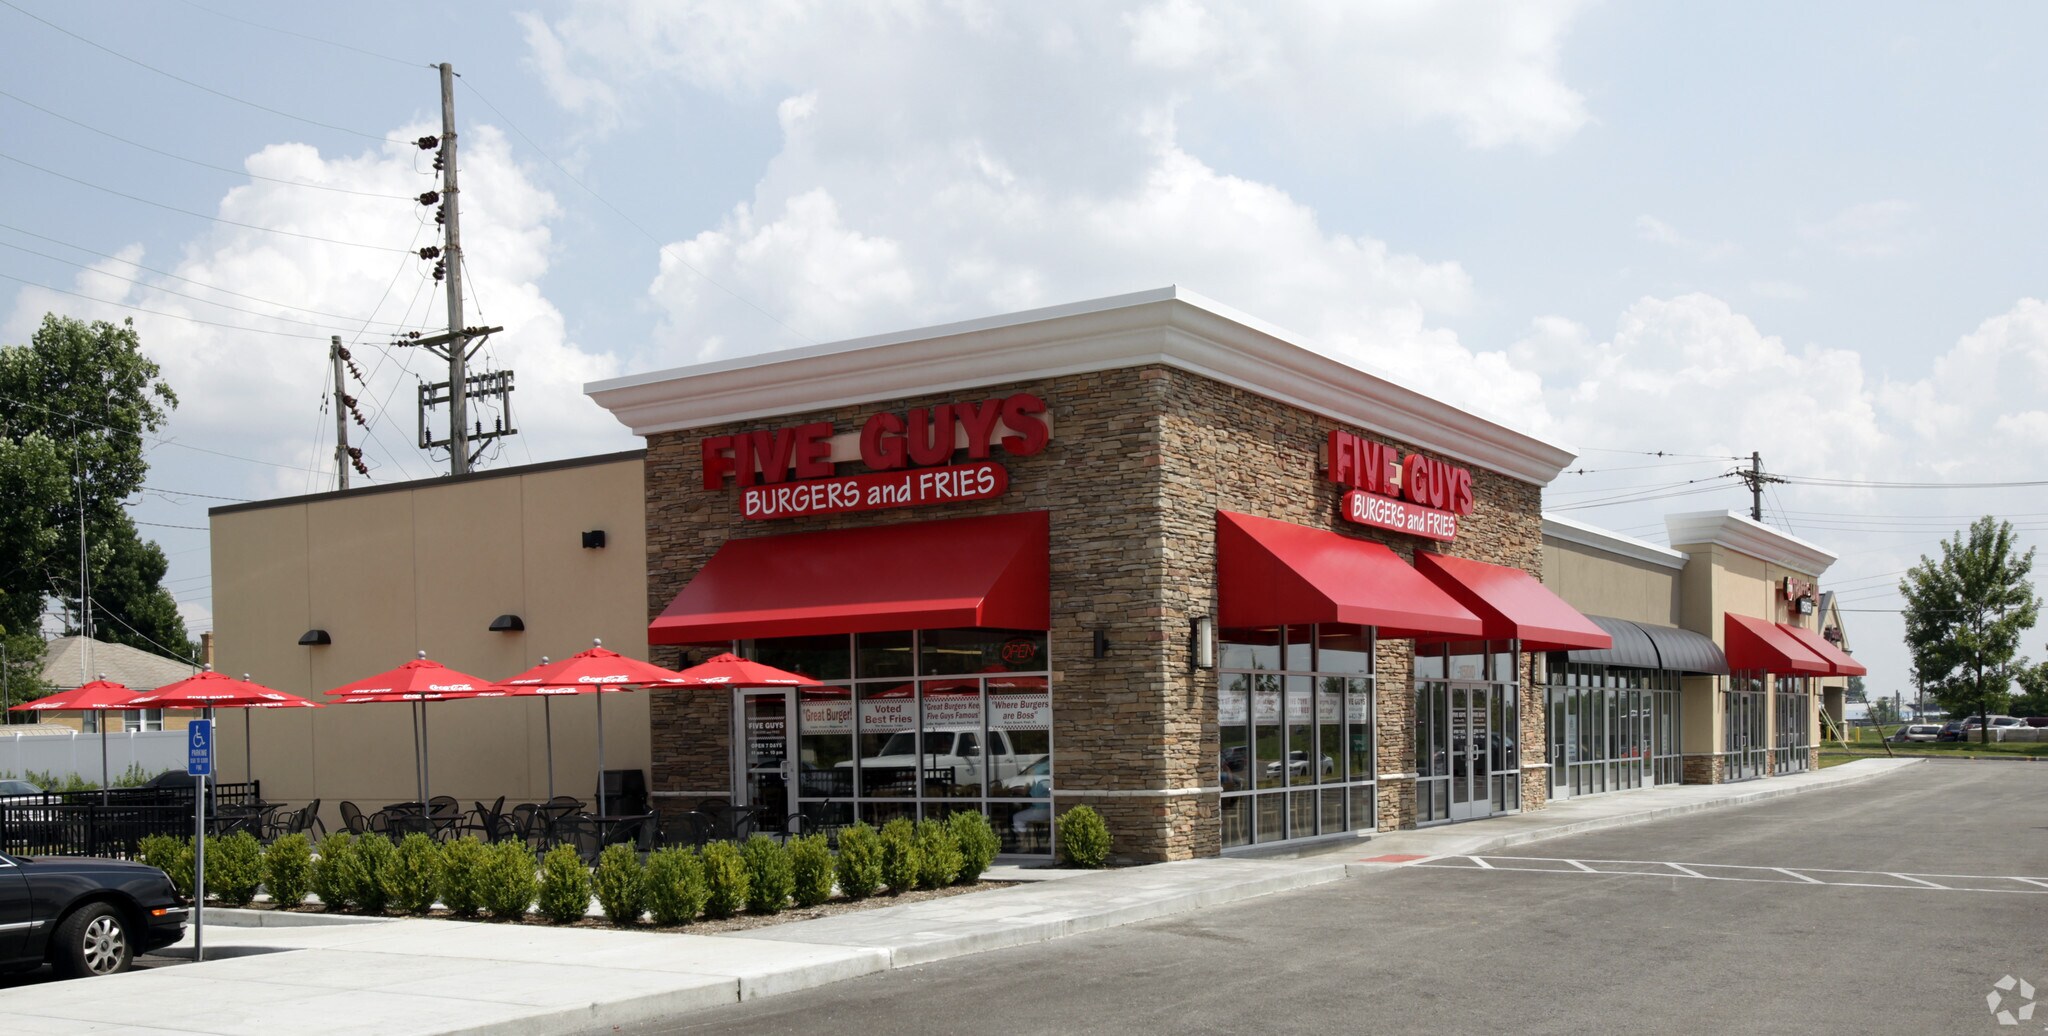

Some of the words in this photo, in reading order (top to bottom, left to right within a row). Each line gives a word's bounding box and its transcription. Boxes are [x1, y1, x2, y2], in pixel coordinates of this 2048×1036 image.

[702, 422, 835, 490] FIVE
[859, 393, 1049, 471] GUYS
[1329, 430, 1399, 497] FIVE
[1402, 453, 1473, 516] GUYS
[745, 481, 859, 516] BURGERS
[867, 476, 911, 505] and
[920, 466, 995, 498] FRIES
[1353, 494, 1405, 528] BURGERS
[1407, 510, 1425, 532] and
[1427, 512, 1455, 537] FRIES
[1002, 643, 1036, 660] OPEN
[875, 705, 902, 713] Voted
[944, 702, 967, 711] Burgers
[1020, 700, 1049, 710] Burgers
[865, 715, 886, 724] Best
[889, 714, 912, 723] Fries
[926, 712, 939, 720] Five
[940, 712, 954, 721] Guys
[1016, 711, 1038, 719] Boss"
[765, 721, 784, 729] GUYS
